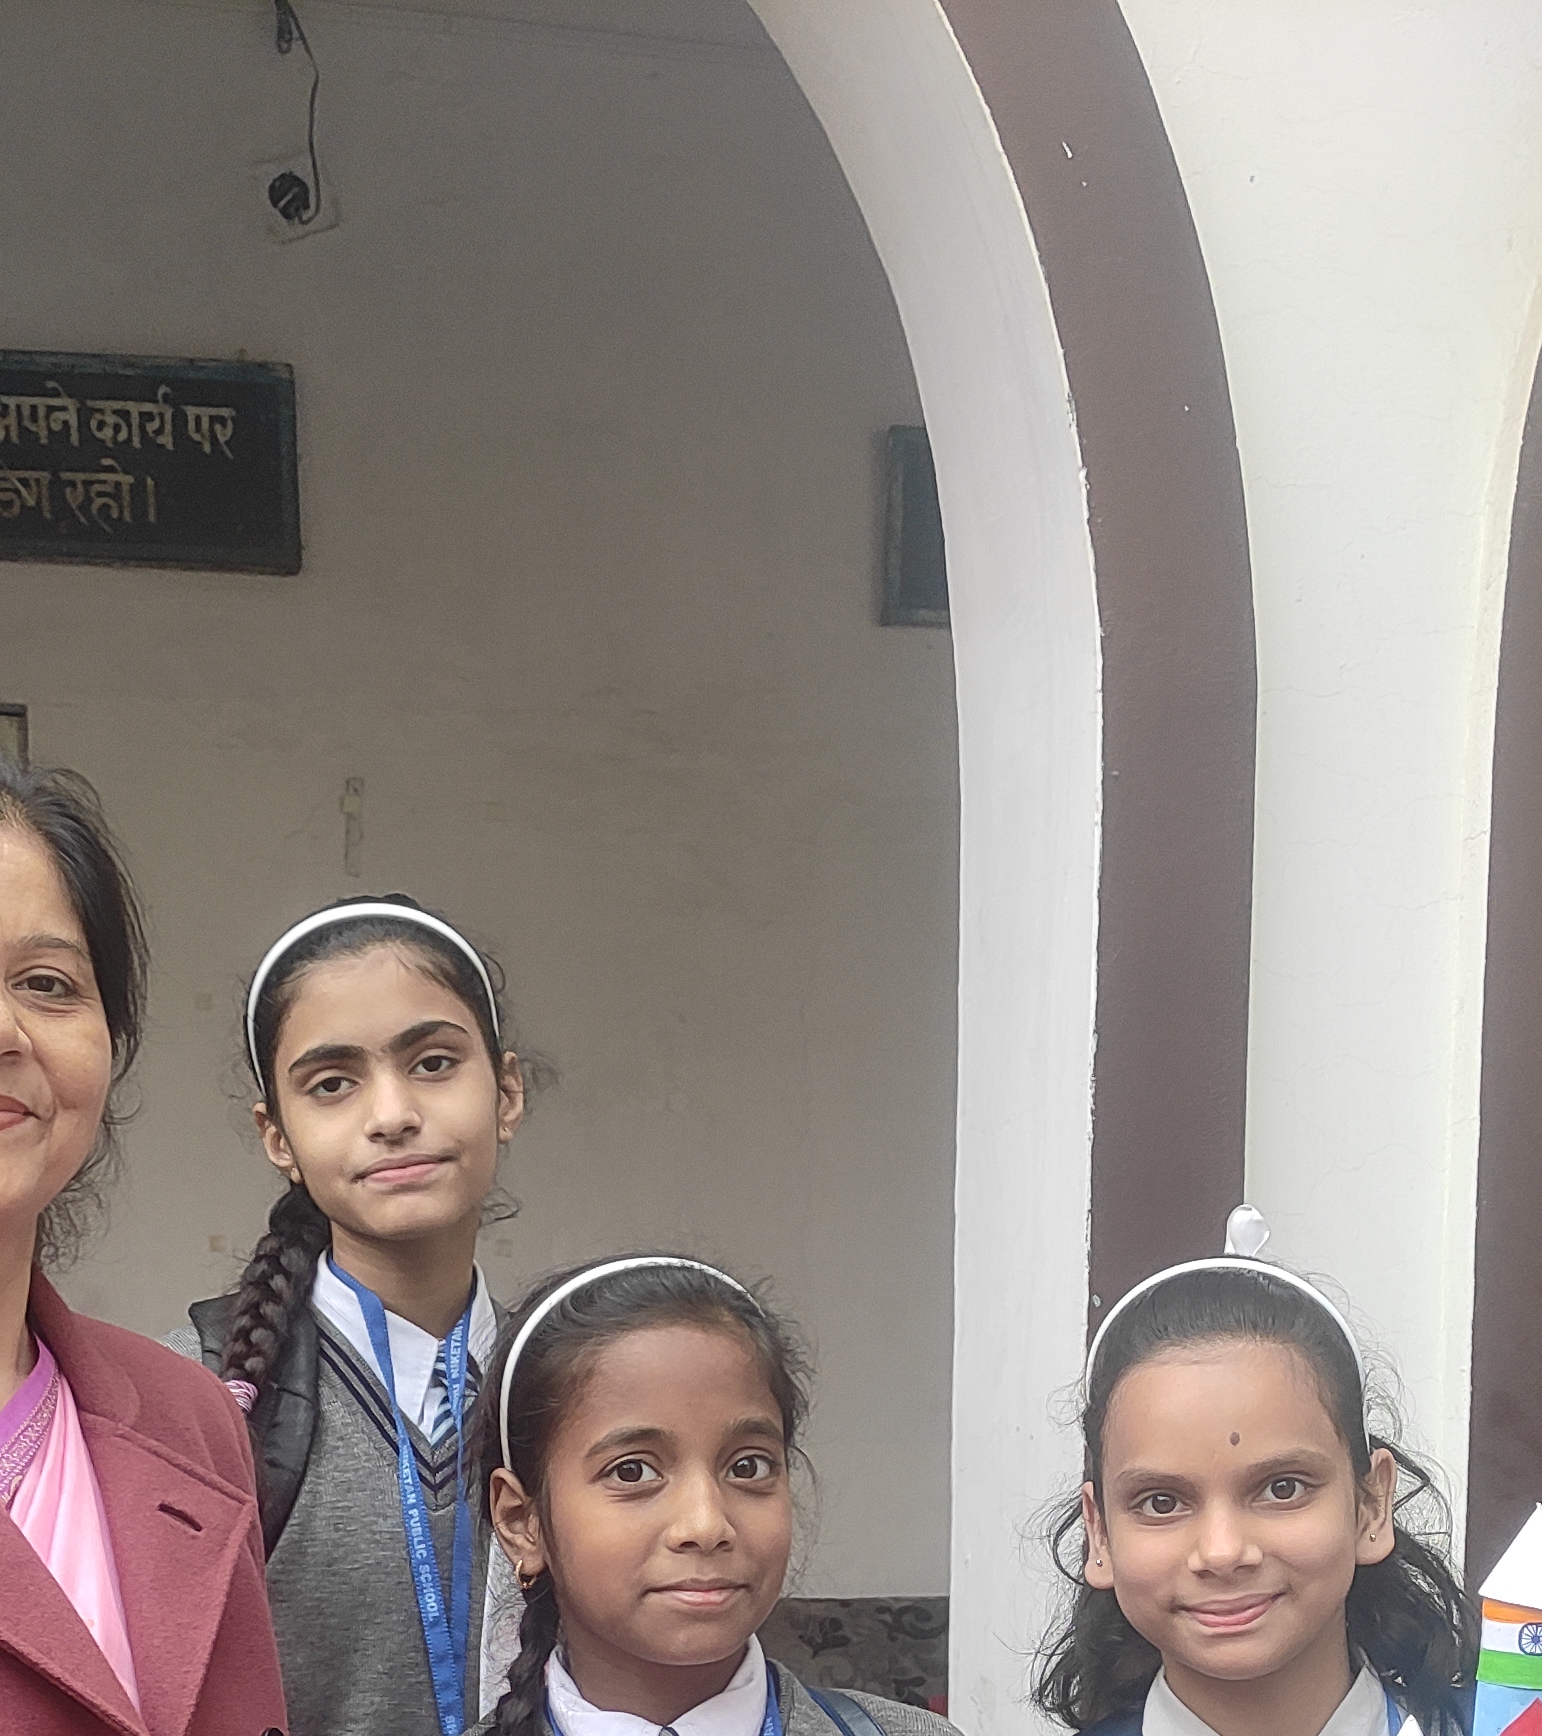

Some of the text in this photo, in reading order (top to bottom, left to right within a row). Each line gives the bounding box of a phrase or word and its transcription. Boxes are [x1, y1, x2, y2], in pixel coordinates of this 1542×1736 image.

[89, 384, 174, 453] कार्य
[186, 404, 236, 460] पर
[408, 1507, 428, 1560] PUBLIC
[418, 1563, 441, 1623] SCHOOL
